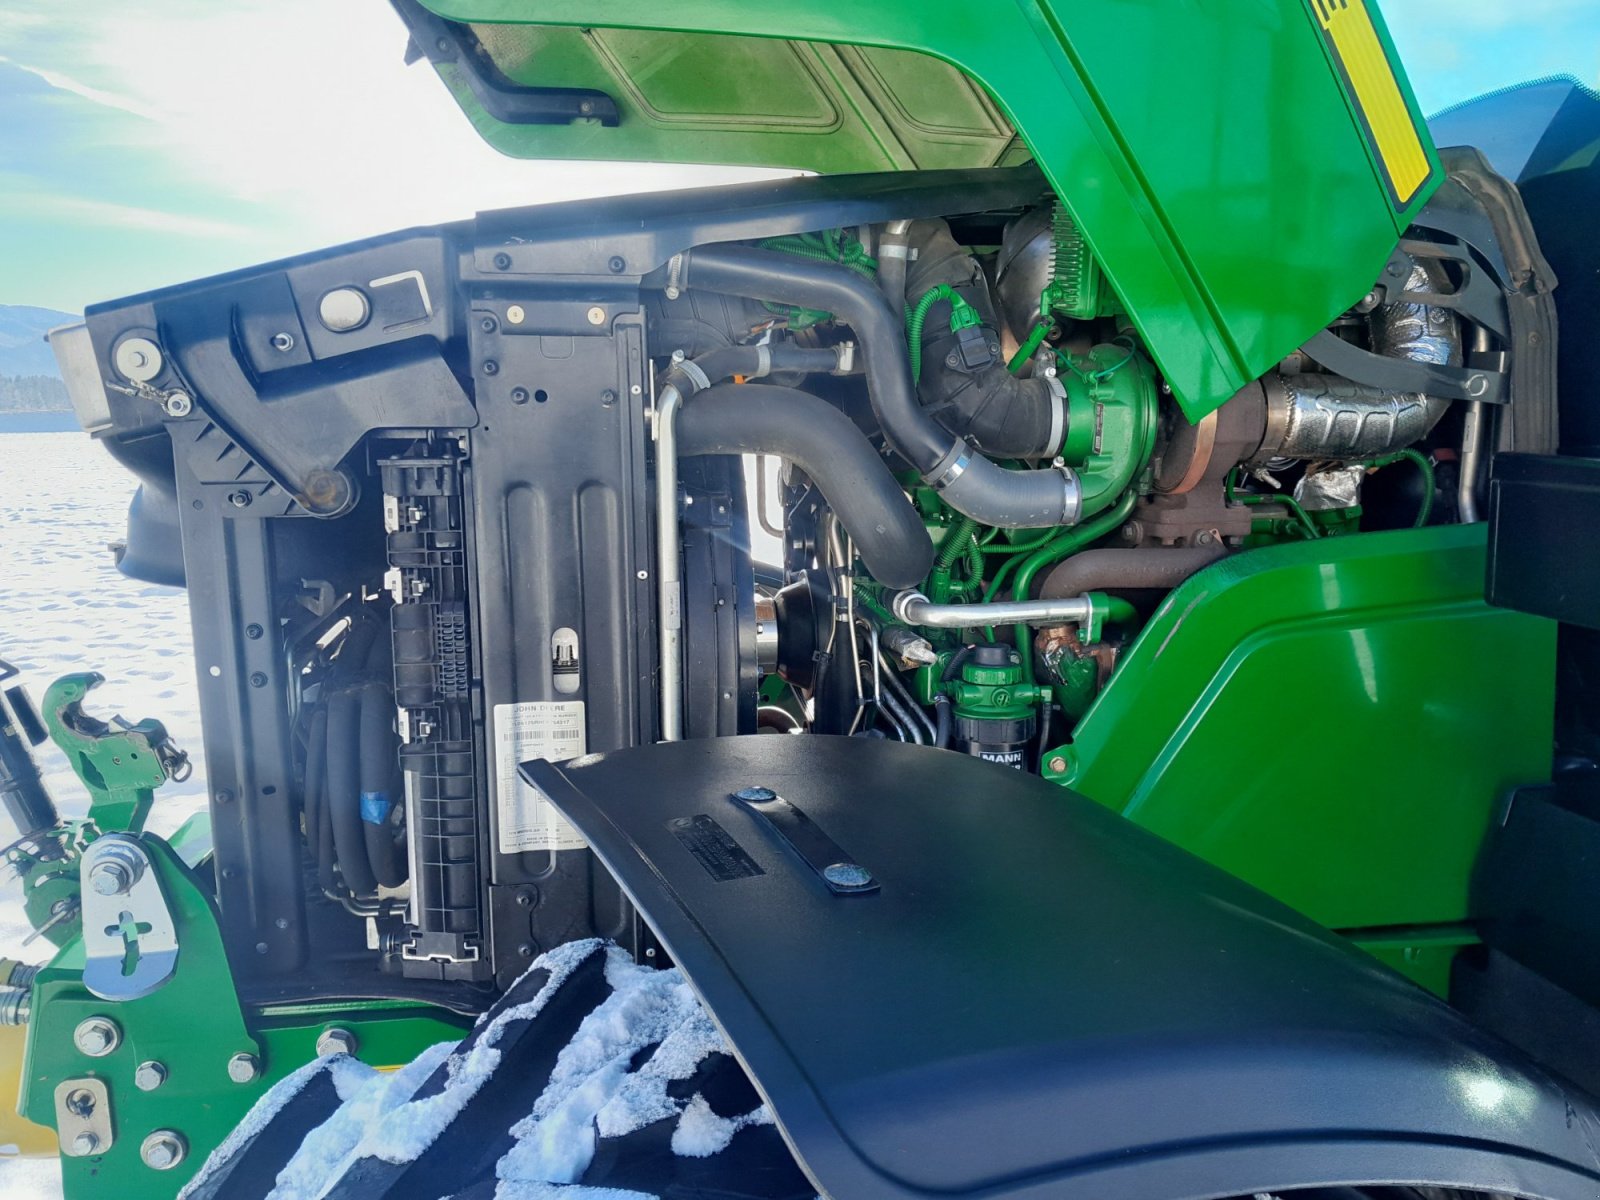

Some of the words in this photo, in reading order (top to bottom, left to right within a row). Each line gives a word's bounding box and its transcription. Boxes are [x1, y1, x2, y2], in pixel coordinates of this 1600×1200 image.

[514, 705, 537, 713] JOHN
[540, 704, 566, 712] DRE
[982, 753, 1022, 763] MANN
